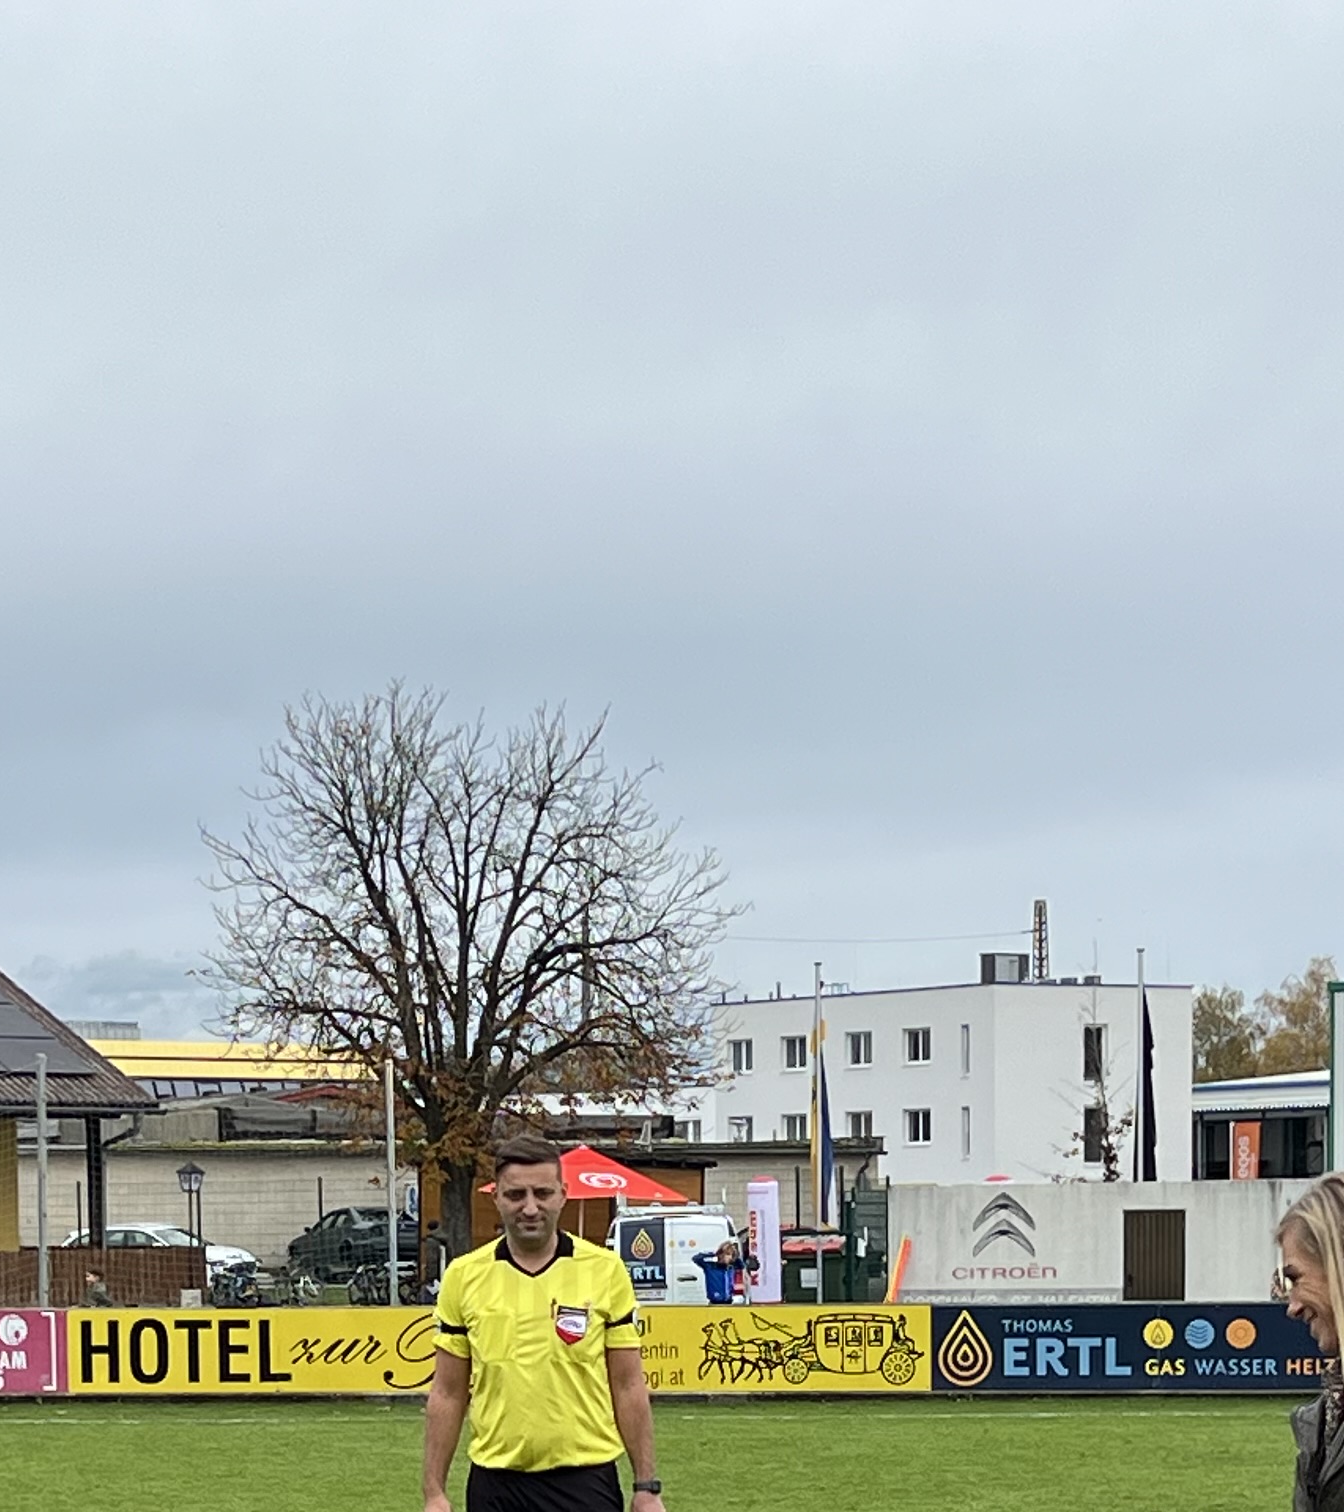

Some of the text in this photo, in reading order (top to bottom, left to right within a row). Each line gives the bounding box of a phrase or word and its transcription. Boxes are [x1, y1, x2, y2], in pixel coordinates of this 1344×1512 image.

[1001, 1319, 1074, 1333] THOMAS
[80, 1317, 293, 1385] HOTEL
[289, 1333, 388, 1366] zur
[1003, 1337, 1133, 1377] ERTL
[1144, 1358, 1187, 1376] GAS
[1194, 1358, 1279, 1376] WASSER
